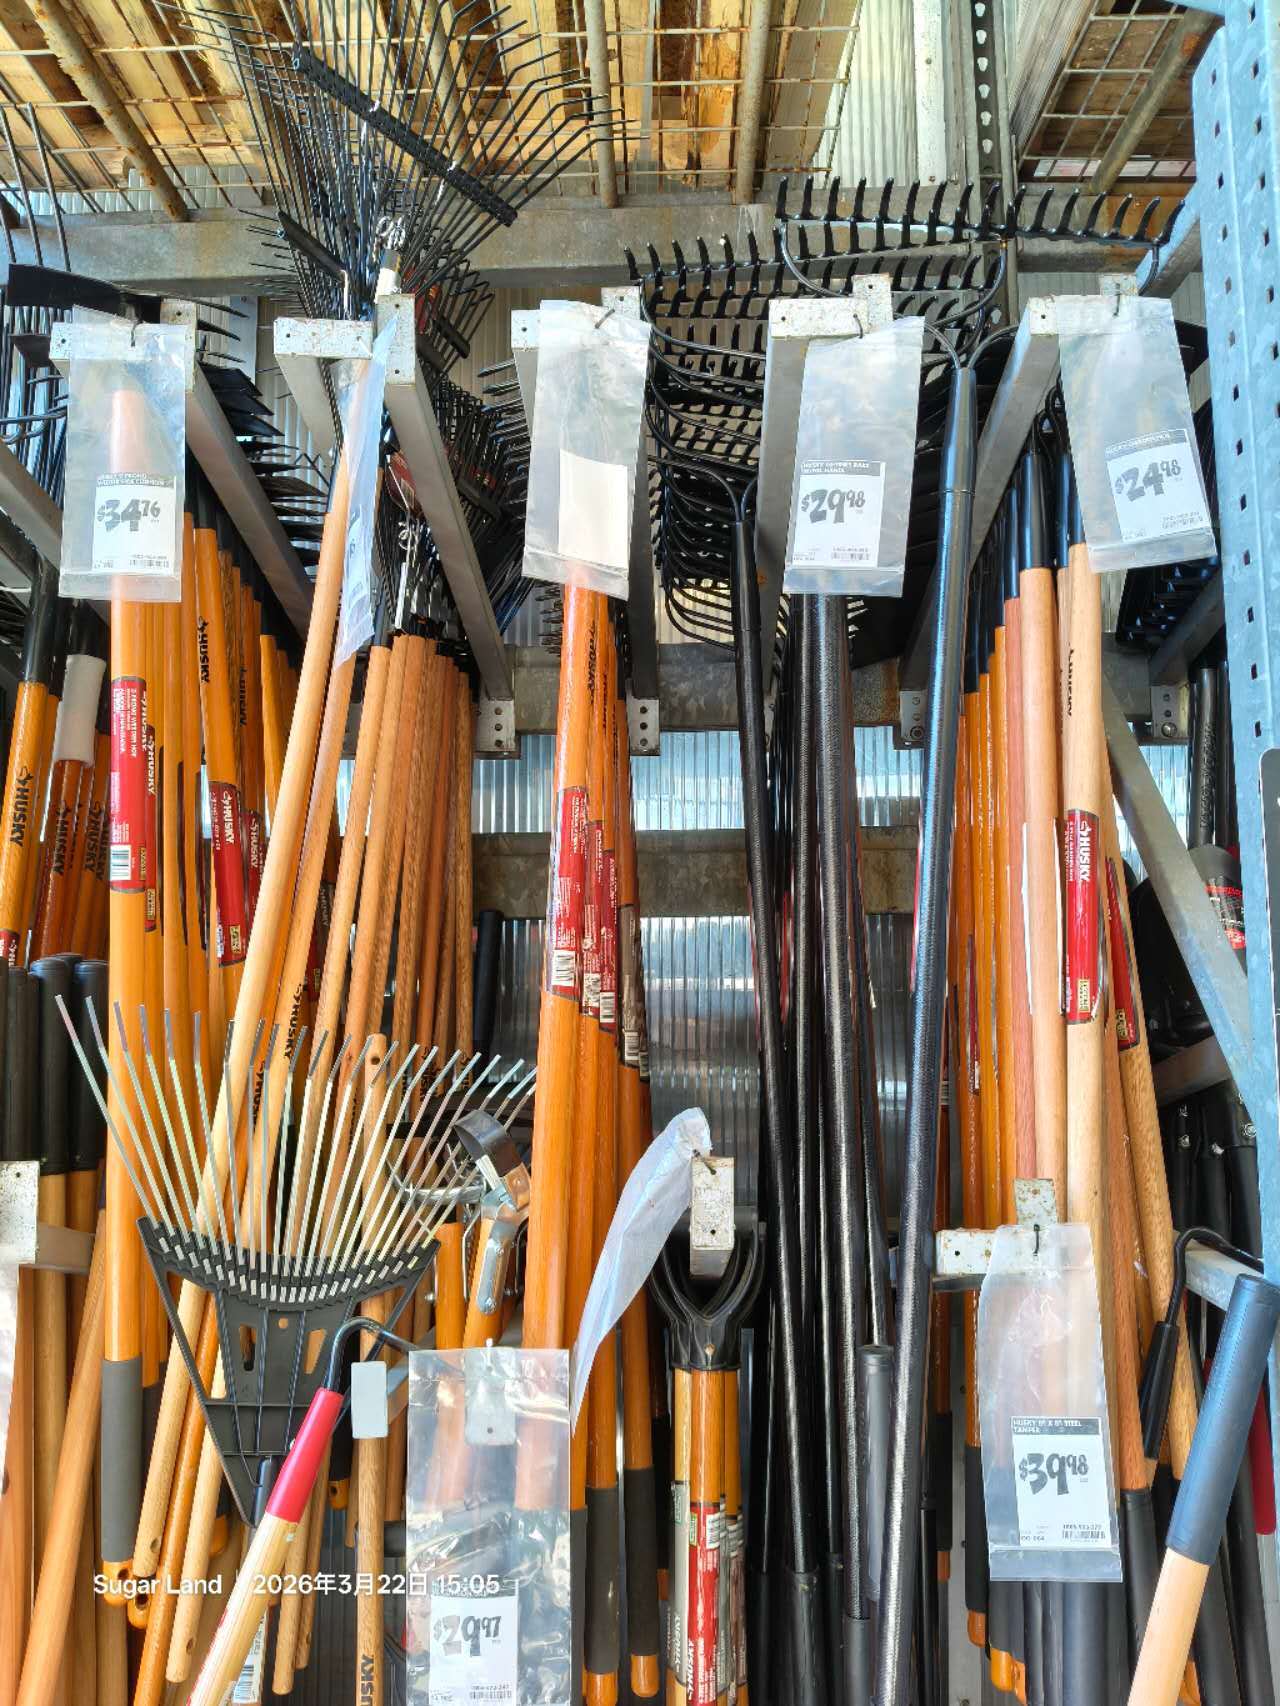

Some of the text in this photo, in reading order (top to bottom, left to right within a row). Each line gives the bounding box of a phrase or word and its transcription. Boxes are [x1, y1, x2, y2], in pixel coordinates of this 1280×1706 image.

[9, 787, 32, 848] HUSKY
[223, 806, 235, 844] HUSKY
[84, 820, 100, 873] HUSKY
[1079, 837, 1091, 882] HUSKY
[284, 1004, 301, 1058] HUSKY
